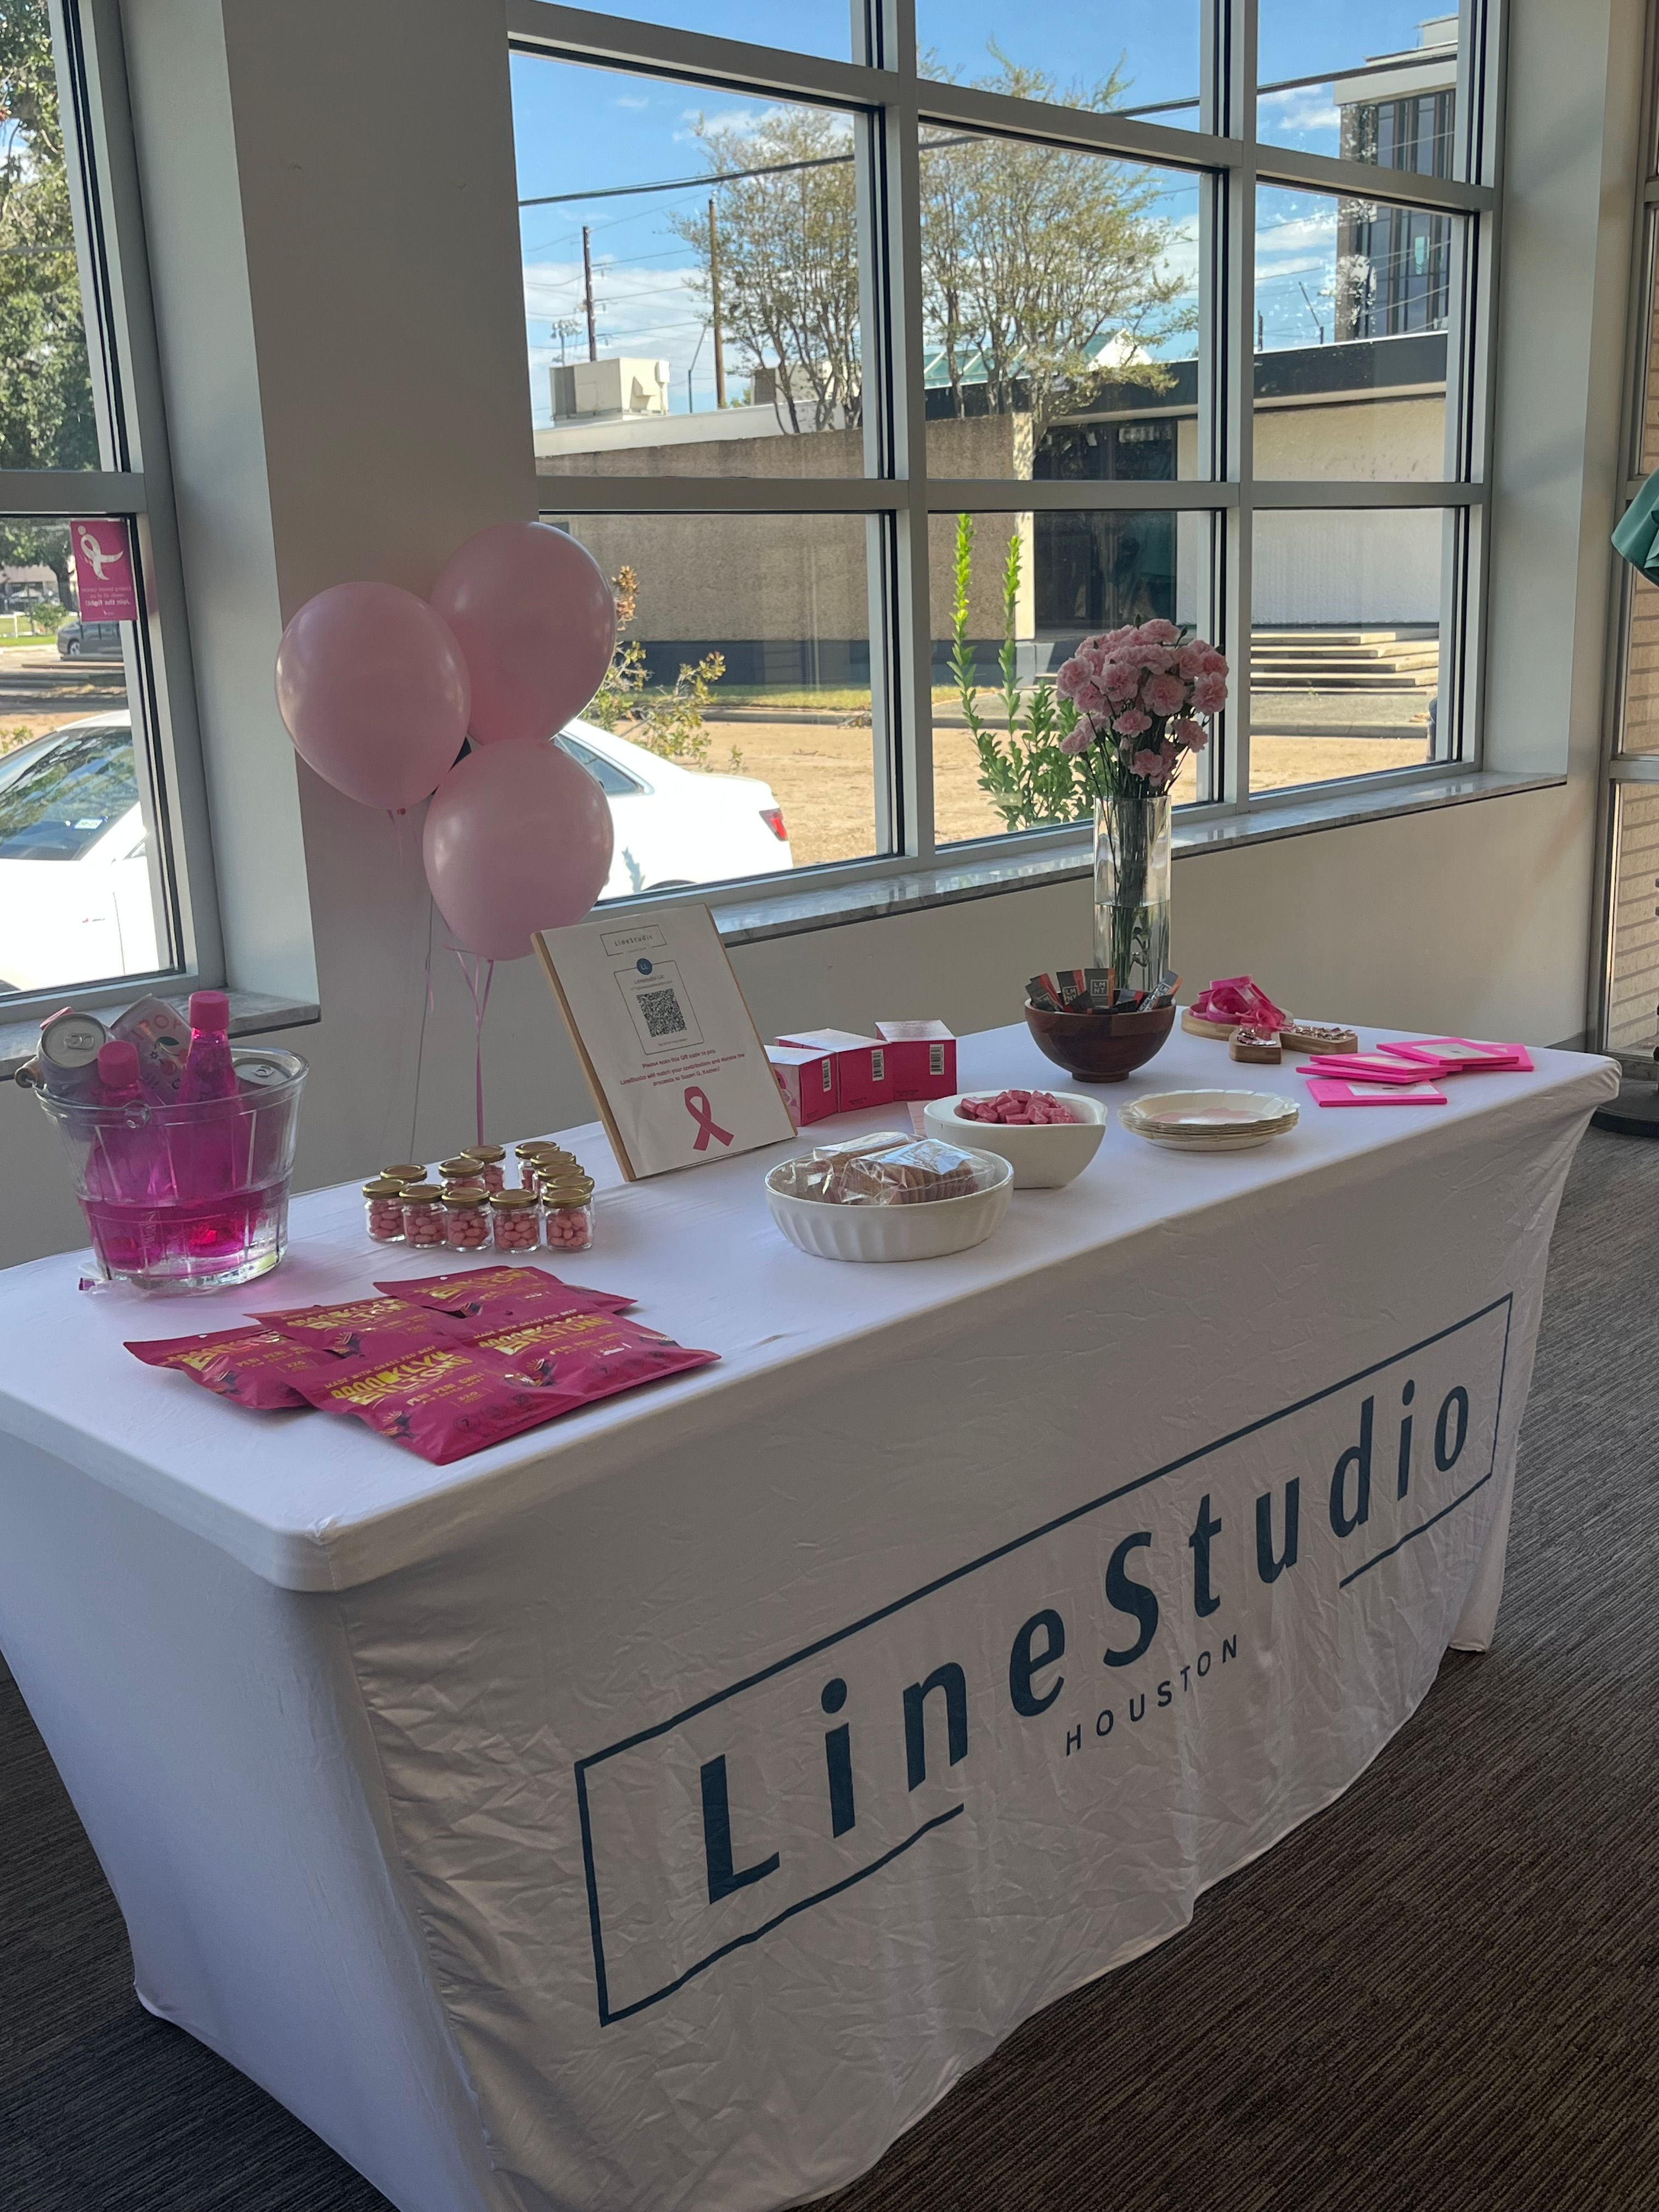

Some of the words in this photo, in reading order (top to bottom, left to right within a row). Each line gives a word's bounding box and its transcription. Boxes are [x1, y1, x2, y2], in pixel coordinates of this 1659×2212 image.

[613, 935, 654, 947] LineStudio
[347, 1356, 473, 1406] BILTONG
[352, 1369, 372, 1379] WITH
[374, 1359, 401, 1371] GRASS
[417, 1345, 437, 1355] BEEF
[699, 1379, 1469, 1905] LineStudio
[1064, 1634, 1239, 1758] HOUSTON
